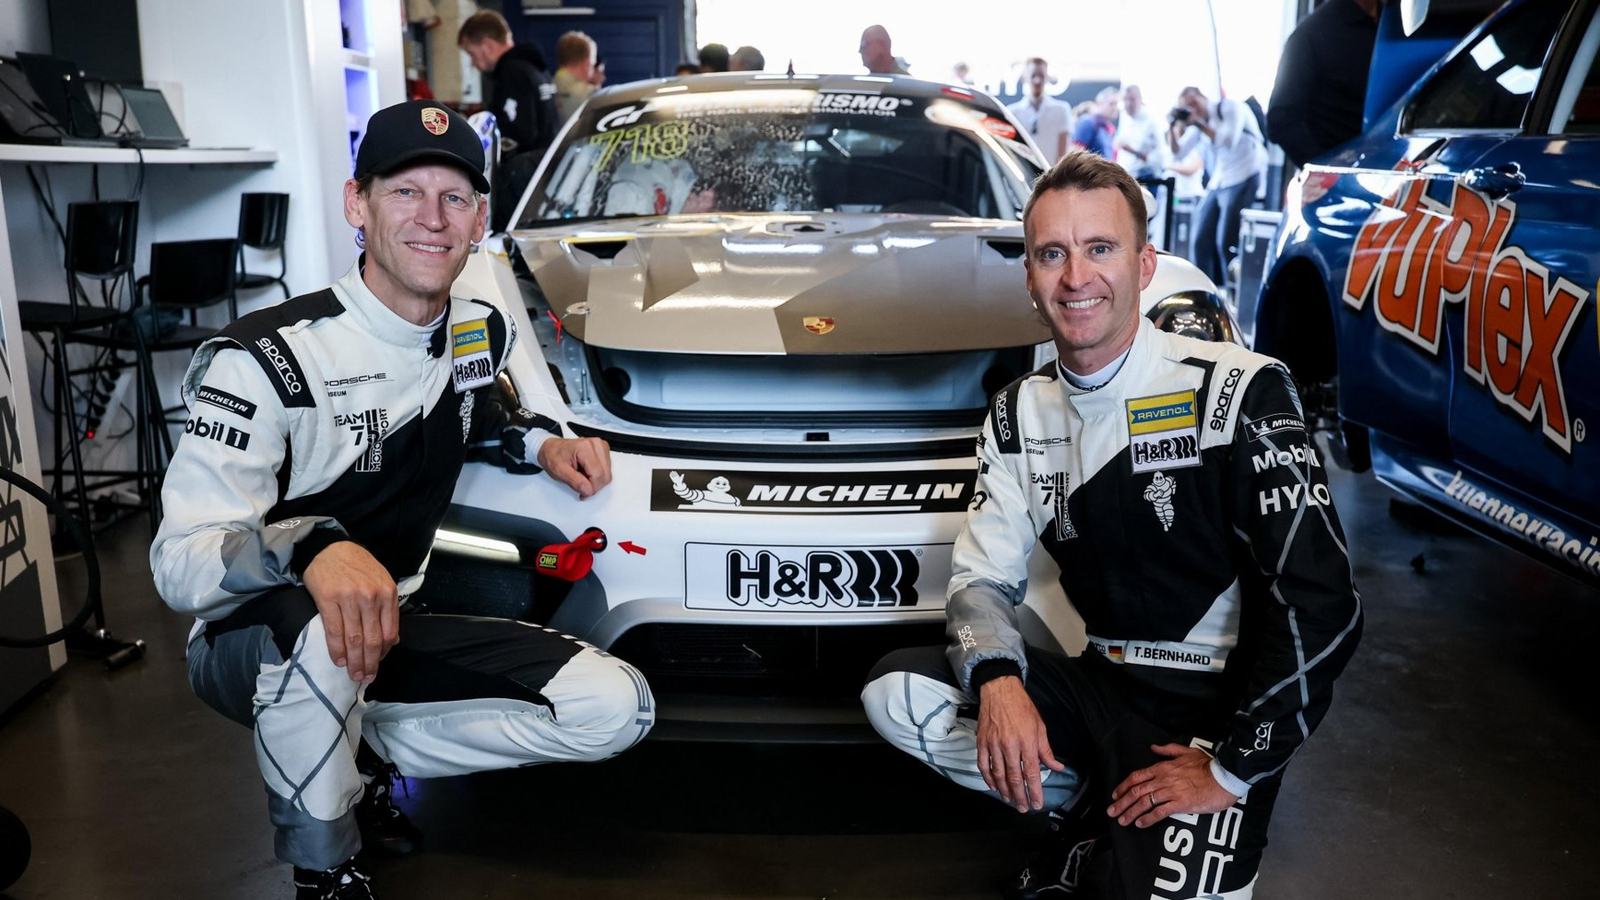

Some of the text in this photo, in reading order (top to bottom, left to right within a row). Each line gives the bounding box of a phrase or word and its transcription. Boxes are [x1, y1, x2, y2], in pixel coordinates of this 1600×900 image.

[590, 120, 689, 172] 718
[257, 337, 302, 394] sparco
[199, 391, 249, 412] MICHELIN
[1210, 368, 1243, 432] sparco
[333, 412, 364, 427] TEAM
[997, 391, 1012, 442] sparco
[1137, 406, 1189, 421] RAVENOL
[185, 416, 225, 442] obil
[1024, 436, 1072, 446] PORSCHE
[1134, 439, 1174, 464] H&R
[1031, 473, 1055, 485] EAM
[747, 483, 965, 501] MICHELIN
[1259, 483, 1331, 515] HYLO
[726, 549, 854, 608] H&R
[1134, 646, 1211, 666] T.BERNHARD
